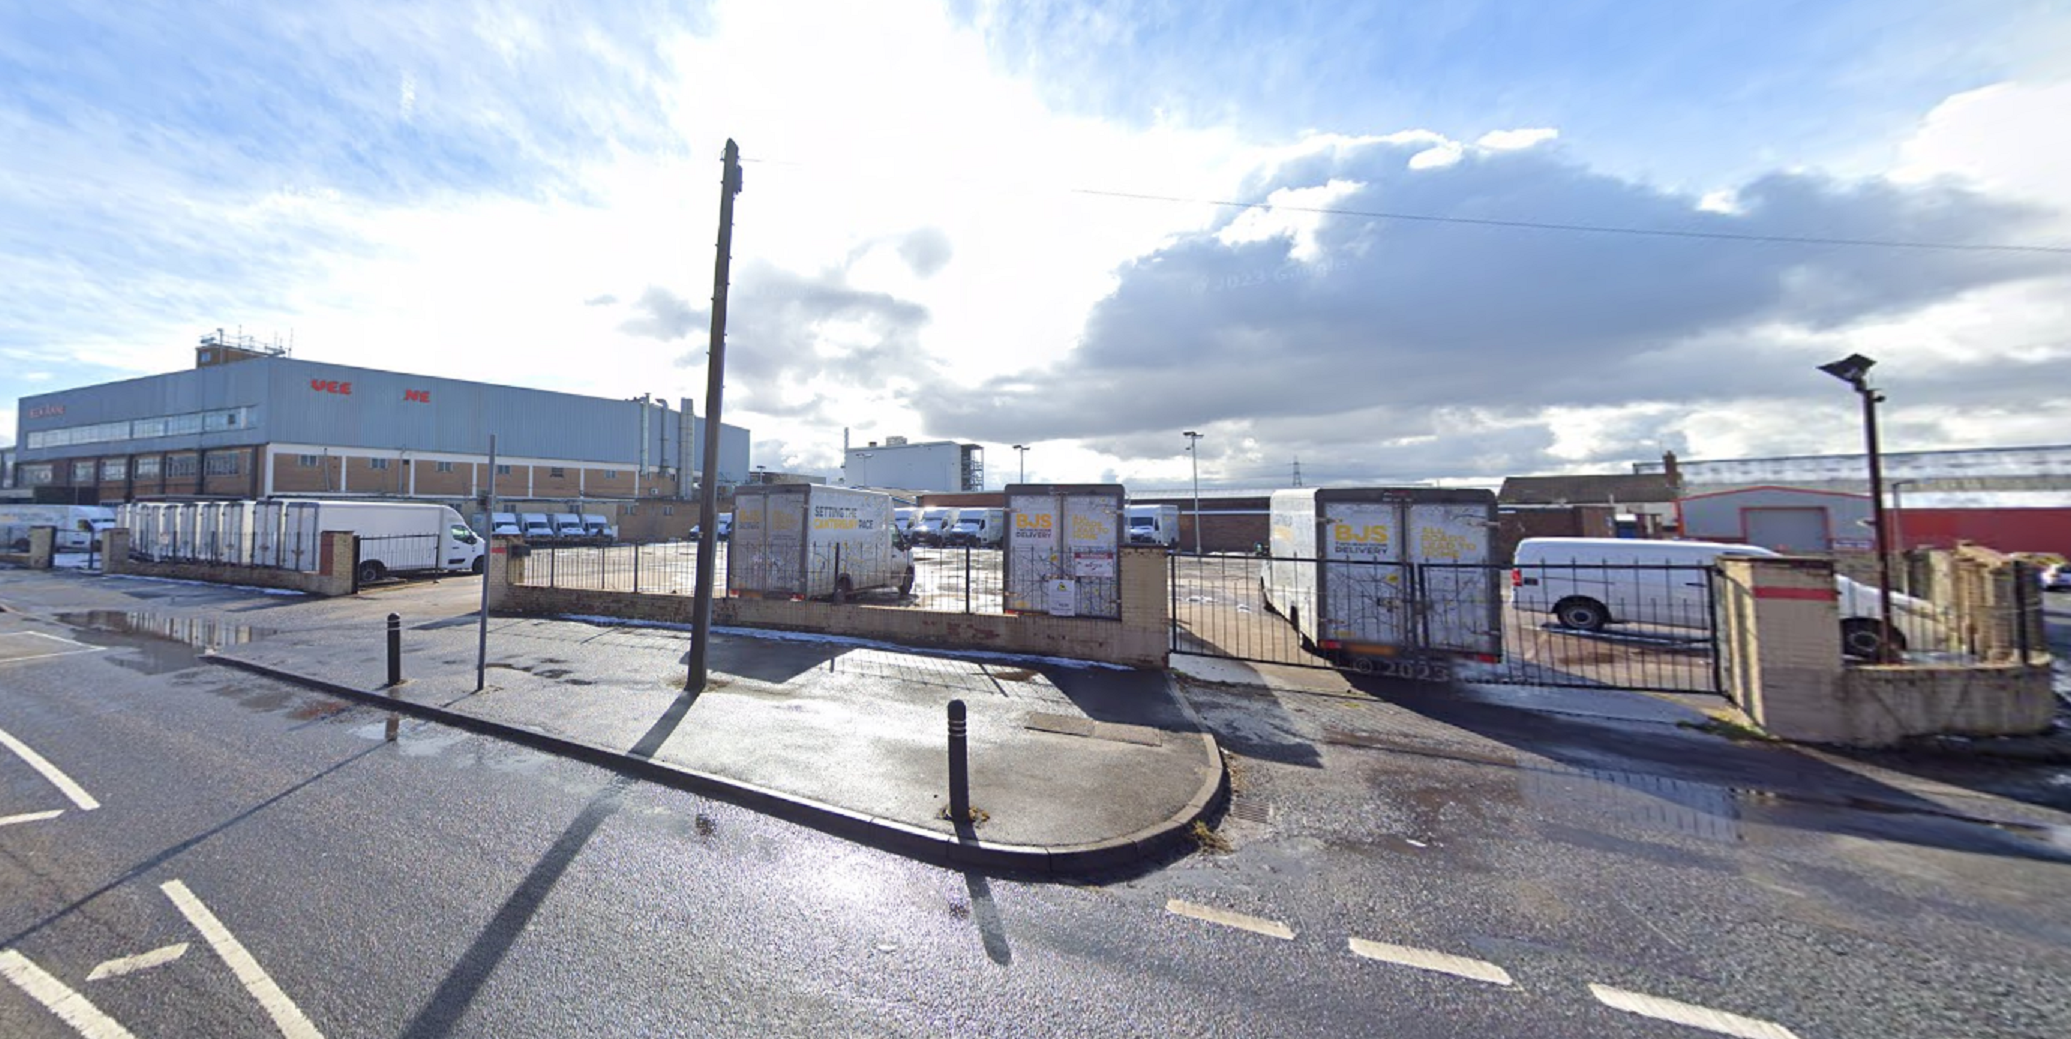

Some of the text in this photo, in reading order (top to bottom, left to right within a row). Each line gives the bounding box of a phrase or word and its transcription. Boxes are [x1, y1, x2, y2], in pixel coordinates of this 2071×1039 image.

[859, 519, 874, 530] PACE
[1016, 513, 1053, 529] BJS
[1016, 531, 1052, 539] DELIVERY
[1335, 524, 1388, 543] BJS
[1335, 546, 1388, 555] DELIVERY
